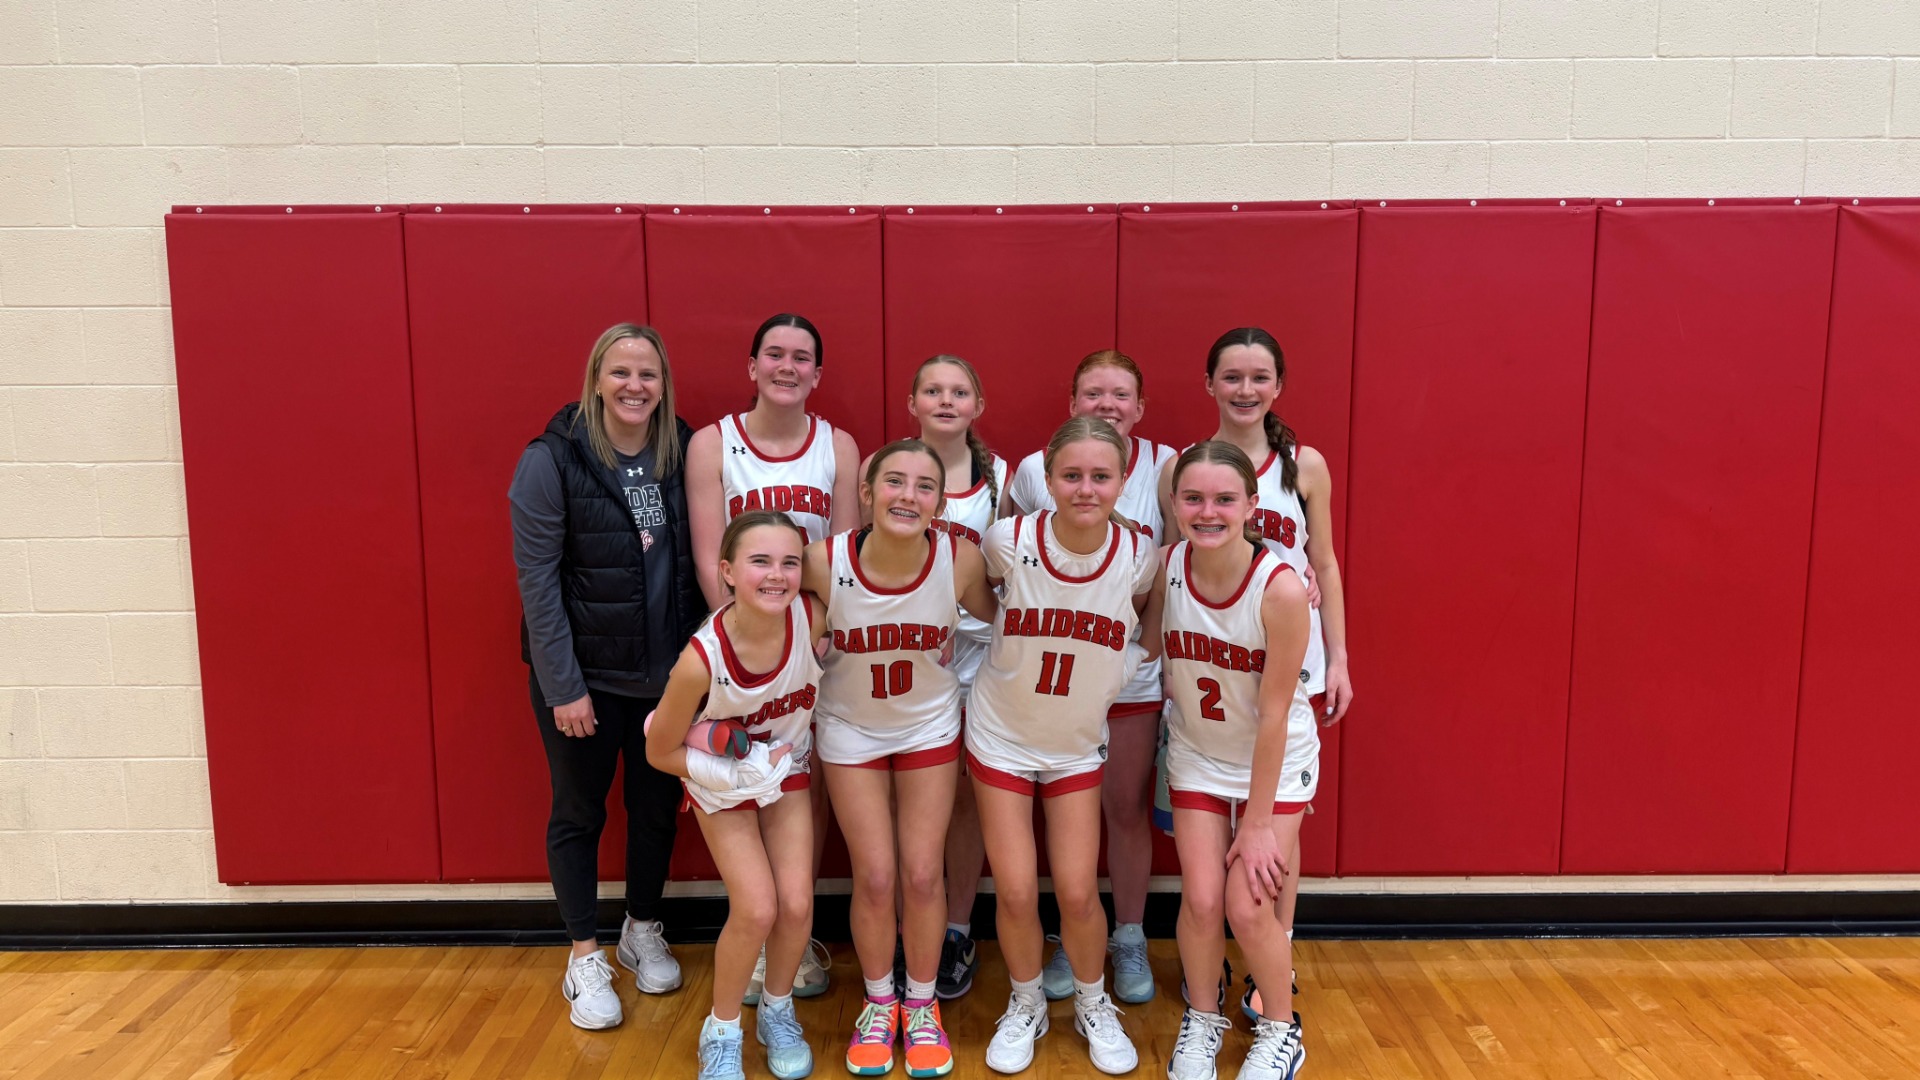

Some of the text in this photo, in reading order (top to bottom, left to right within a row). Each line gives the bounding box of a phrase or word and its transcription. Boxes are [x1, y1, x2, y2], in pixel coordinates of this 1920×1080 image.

[729, 485, 831, 520] RAIDERS
[1003, 608, 1126, 652] RAIDERS
[870, 660, 913, 699] 10
[1035, 651, 1075, 696] 11
[1196, 677, 1226, 721] 2
